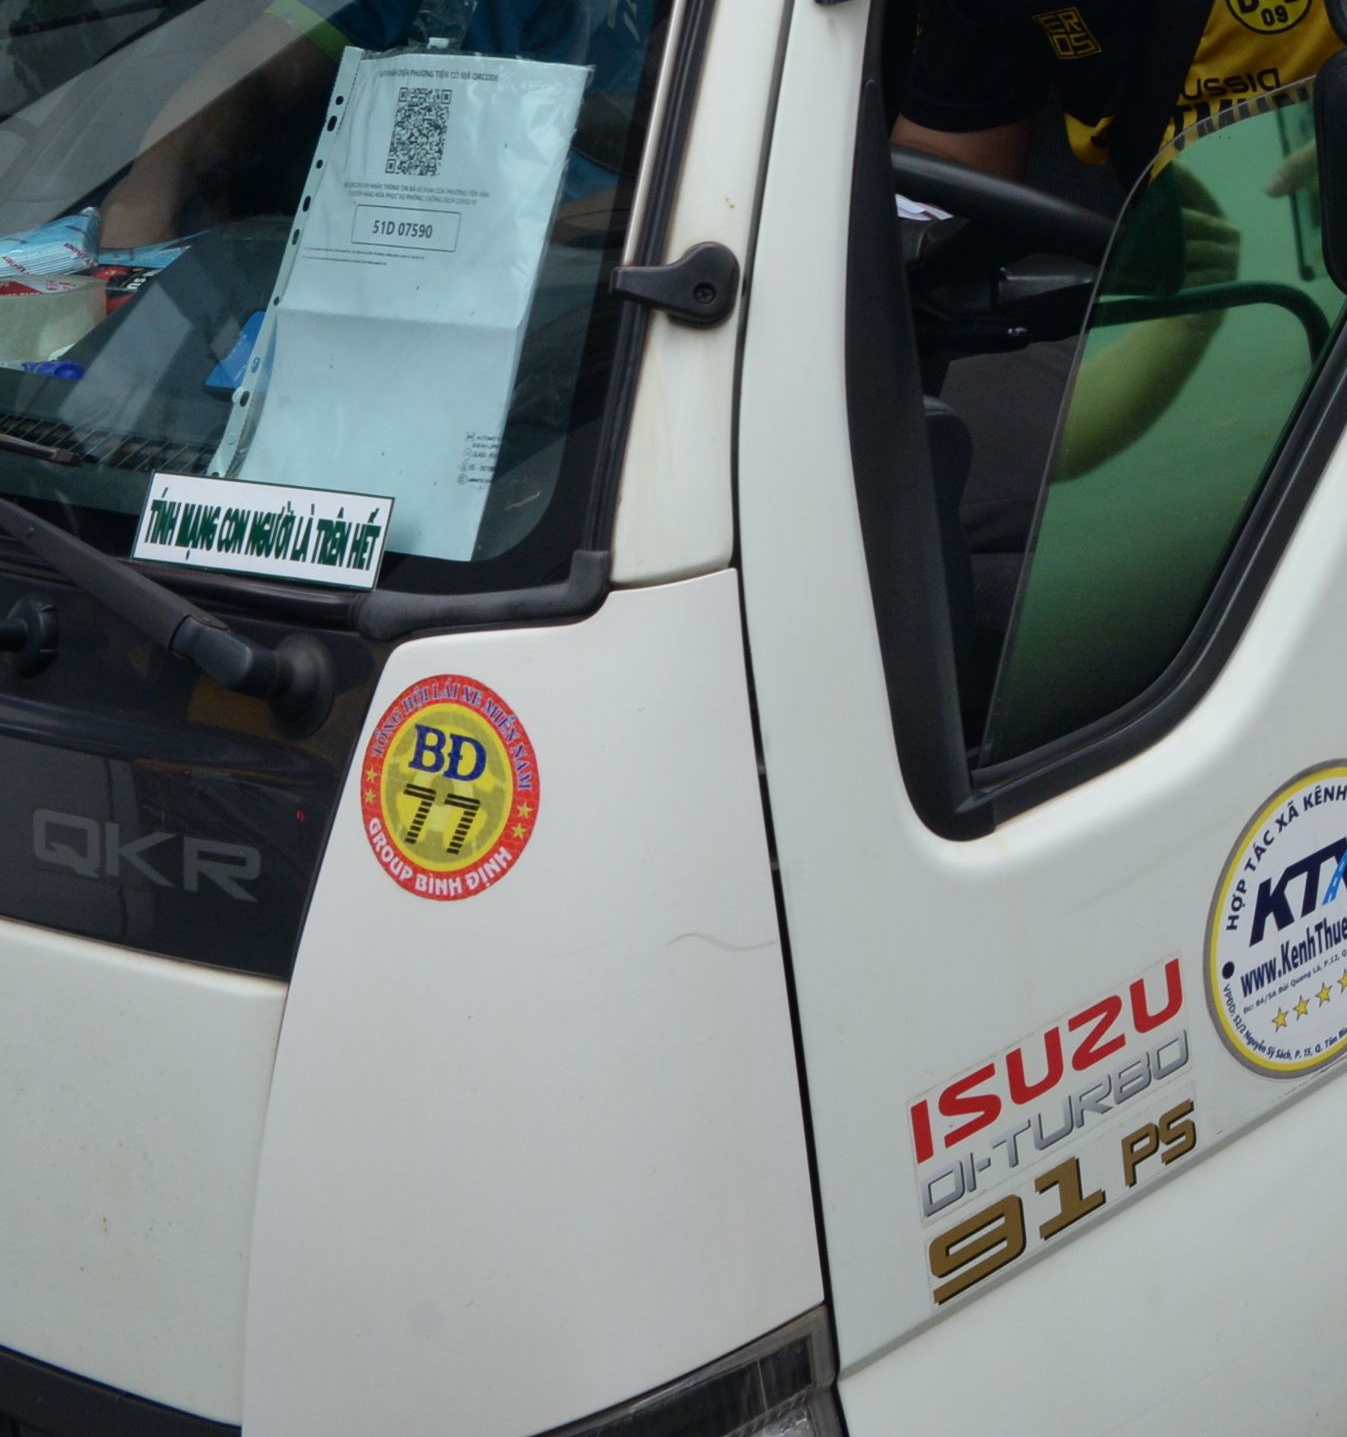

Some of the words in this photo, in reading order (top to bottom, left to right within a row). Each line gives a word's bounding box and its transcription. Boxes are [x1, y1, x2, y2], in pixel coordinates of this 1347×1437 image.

[1260, 4, 1289, 26] 09
[372, 219, 393, 236] 51D
[397, 221, 433, 239] 07590
[174, 502, 222, 561] MẠNG
[217, 506, 252, 554] CON
[290, 503, 315, 563] LÀ
[311, 507, 353, 568] TRÊN
[346, 508, 383, 571] HẾT
[432, 678, 460, 700] LÁI
[460, 685, 484, 706] XE
[510, 744, 533, 791] NAM
[33, 808, 261, 903] QKR
[369, 817, 414, 880] GROUP
[414, 872, 463, 897] BÌNH
[465, 845, 513, 890] ĐỊNH
[403, 783, 481, 855] 77
[1226, 879, 1248, 931] HỢP
[1244, 830, 1275, 872] TÁC
[1275, 799, 1299, 834] XÃ
[1303, 784, 1347, 812] KÊNH
[1290, 972, 1312, 987] Quang
[910, 958, 1183, 1164] ISUZU
[922, 1028, 1189, 1218] DI-TURBO
[928, 1155, 1106, 1306] 91
[1121, 1098, 1197, 1188] PS
